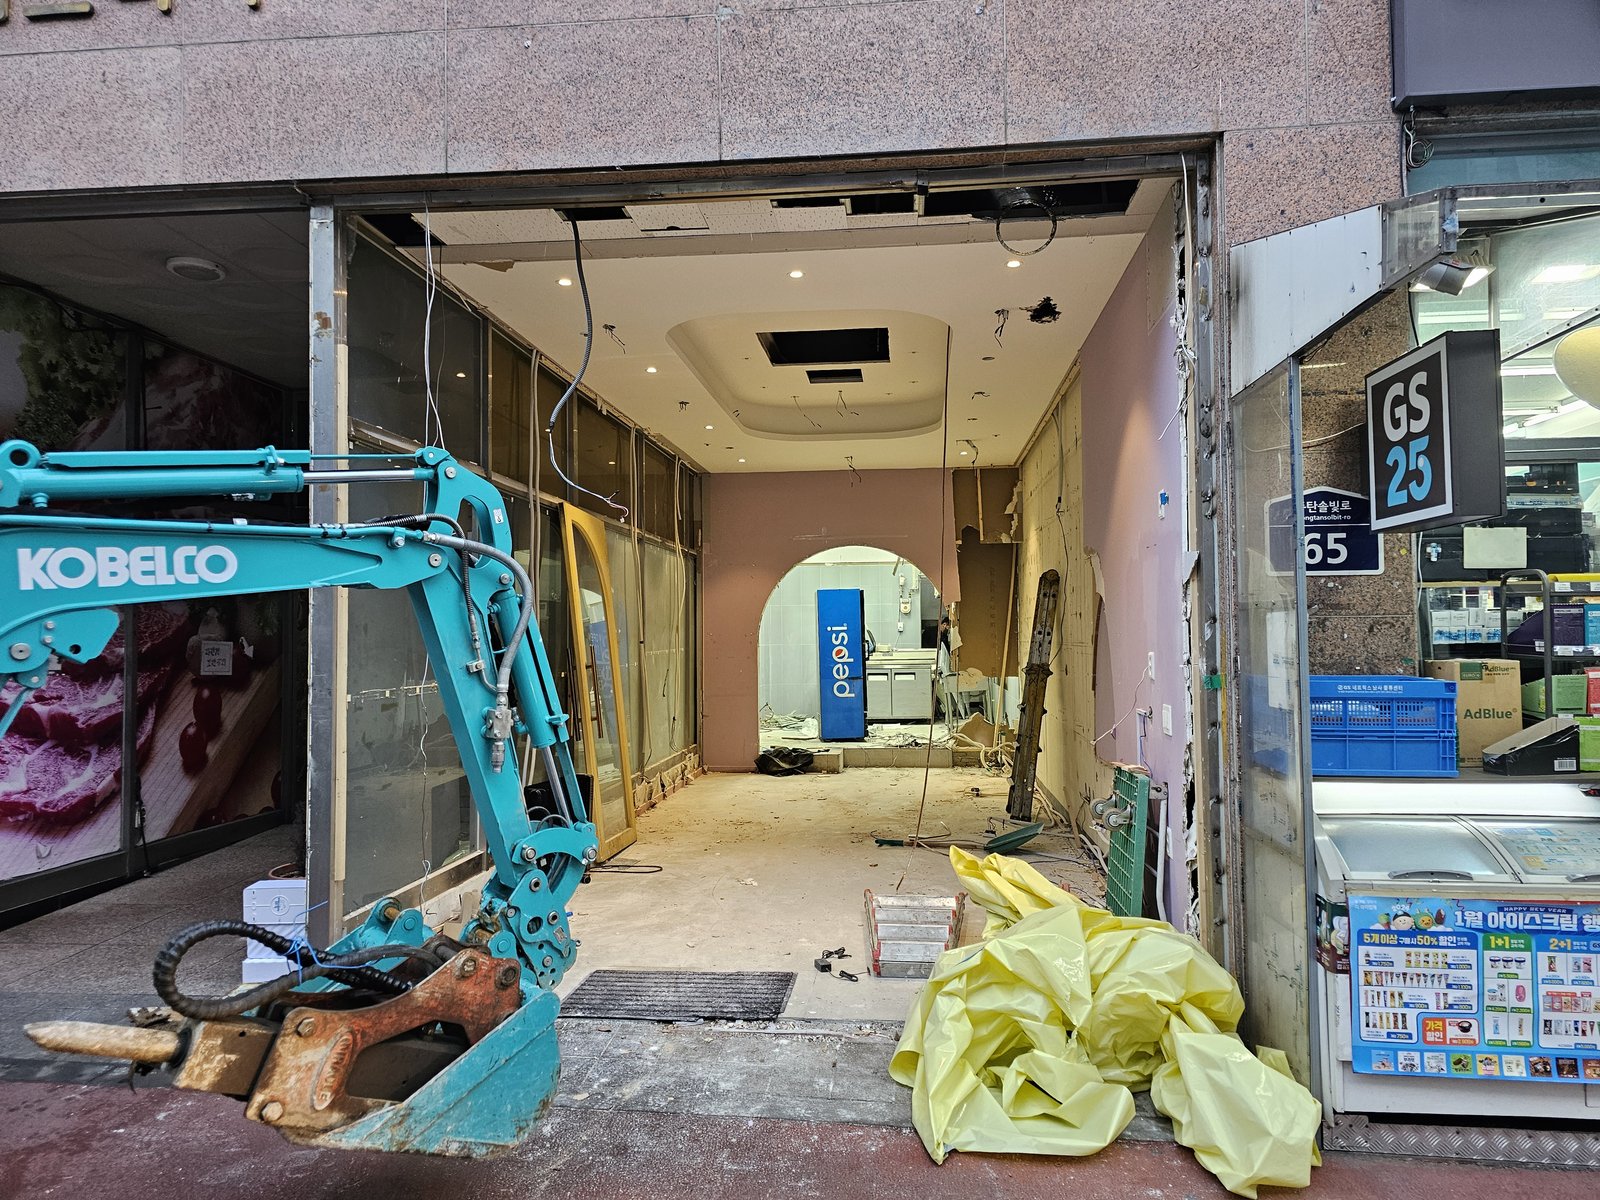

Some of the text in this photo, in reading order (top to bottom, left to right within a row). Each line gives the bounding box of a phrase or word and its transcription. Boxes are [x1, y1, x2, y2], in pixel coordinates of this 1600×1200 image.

[1382, 371, 1431, 442] GS
[1386, 434, 1433, 508] 25
[1303, 500, 1352, 513] 탄솔빛로
[1304, 532, 1348, 565] 65
[18, 544, 239, 591] KOBELCO
[827, 625, 855, 698] pepsi
[1463, 708, 1513, 720] AdBlue
[1454, 910, 1484, 929] 1월
[1487, 911, 1578, 932] 아이스크림
[1380, 934, 1398, 945] 이상
[1417, 935, 1438, 946] 50%
[1438, 936, 1457, 947] 할인
[1489, 935, 1511, 949] 1+1
[1549, 938, 1572, 951] 2+1
[1425, 1020, 1443, 1031] 가격
[1425, 1031, 1444, 1042] 할인
